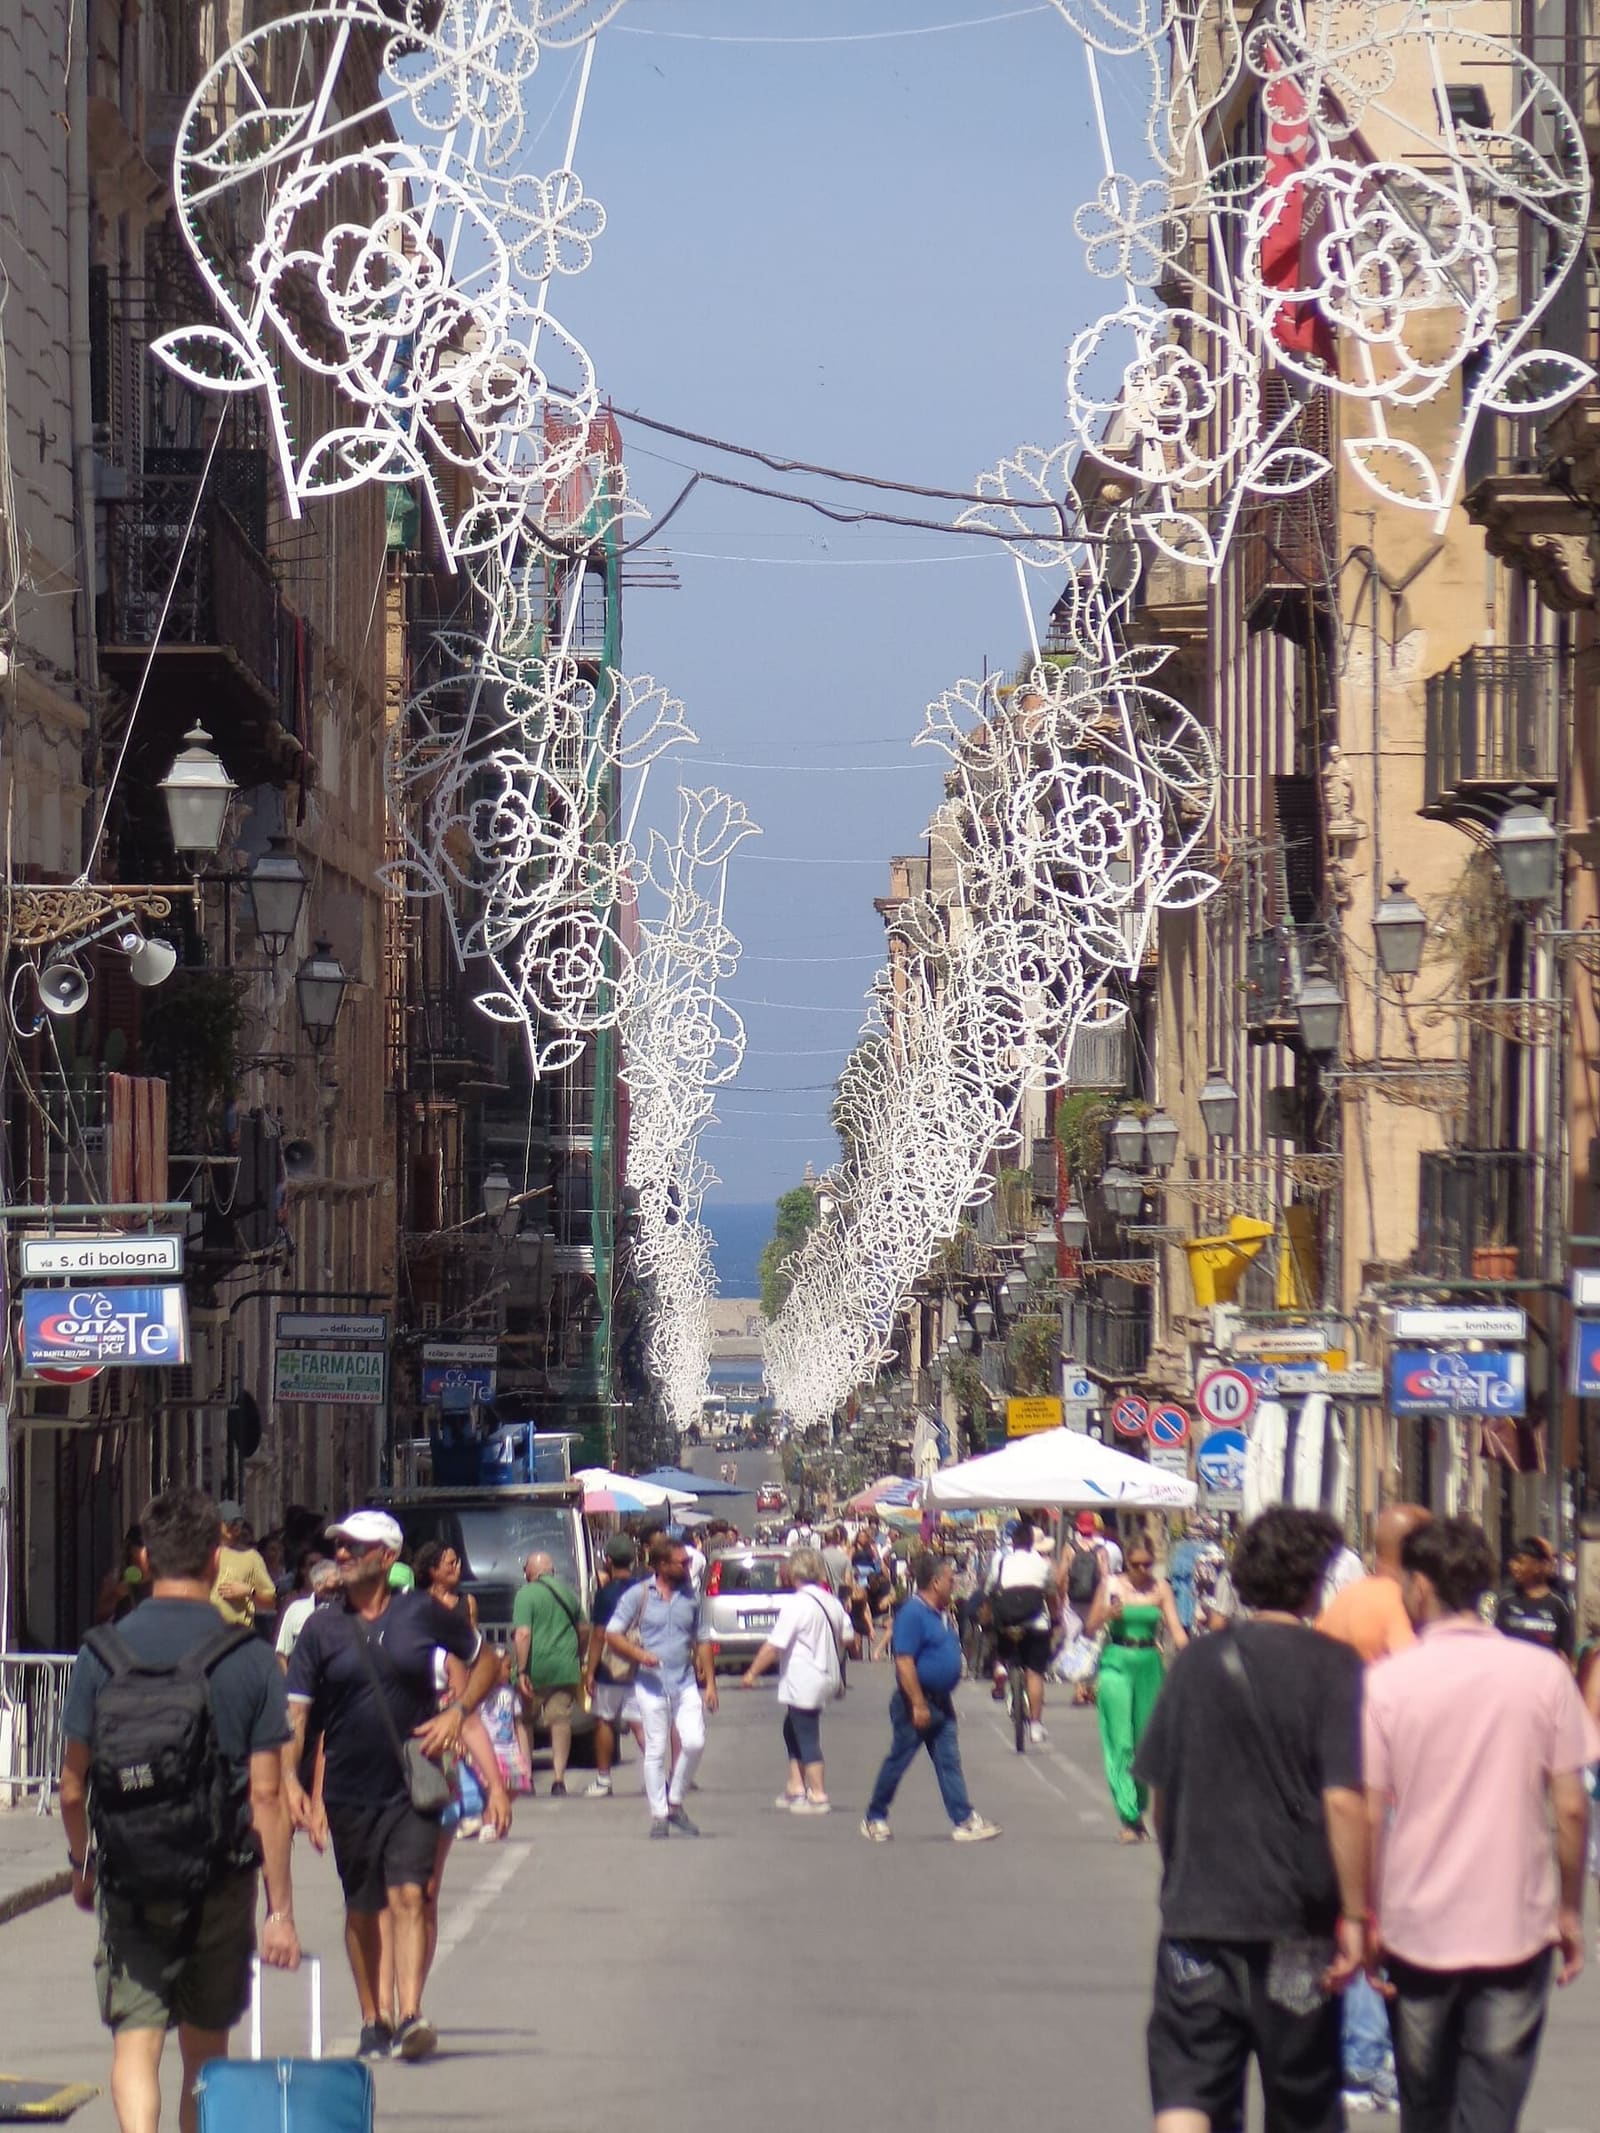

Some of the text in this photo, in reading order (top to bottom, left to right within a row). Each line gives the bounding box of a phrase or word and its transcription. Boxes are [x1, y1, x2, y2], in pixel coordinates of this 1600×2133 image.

[60, 1256, 74, 1266] s.
[78, 1252, 94, 1266] di
[99, 1252, 167, 1266] bologna
[69, 1291, 113, 1320] C'è
[116, 1312, 169, 1355] Te
[353, 1325, 380, 1334] scuole
[98, 1342, 125, 1359] per
[301, 1354, 381, 1375] FARMACIA
[1213, 1384, 1239, 1411] 10
[1469, 1370, 1516, 1408] Te
